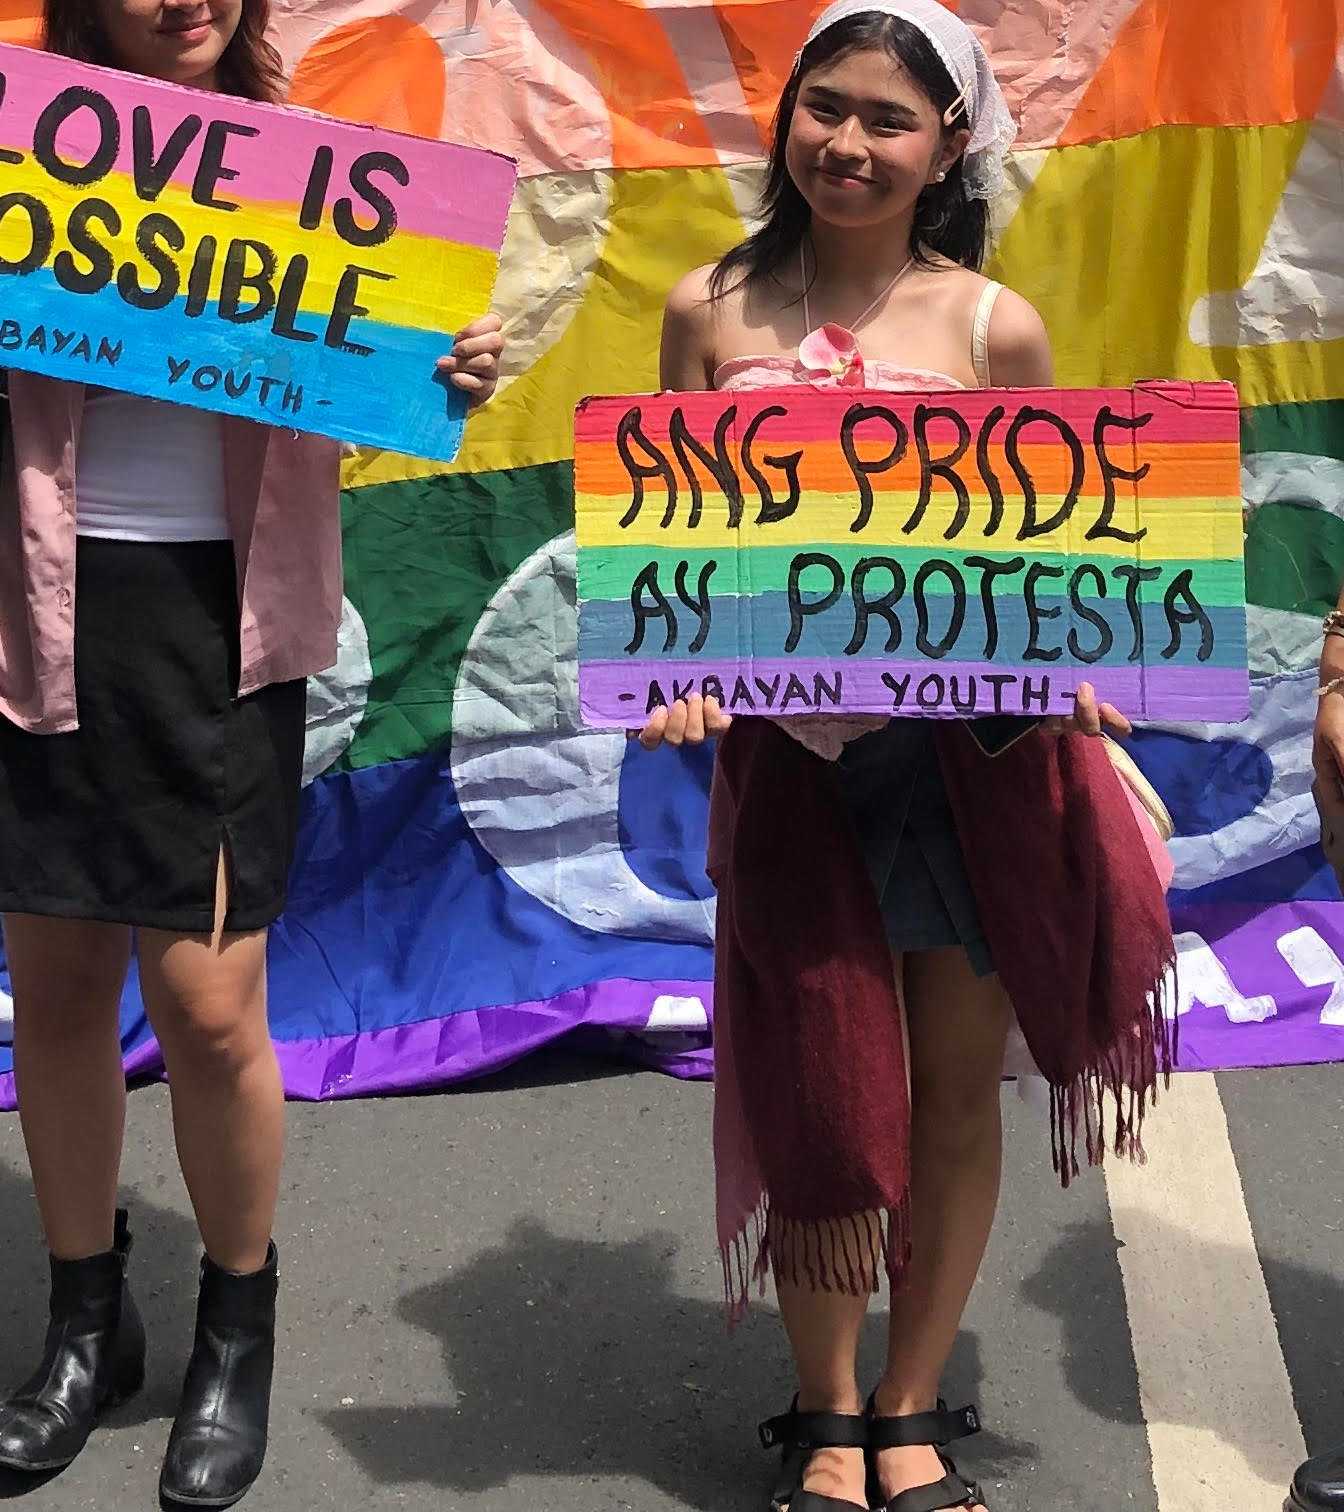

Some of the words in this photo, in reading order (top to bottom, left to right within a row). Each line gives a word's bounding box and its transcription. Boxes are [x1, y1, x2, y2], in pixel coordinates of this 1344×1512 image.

[299, 144, 411, 248] IS
[616, 404, 804, 530] ANG
[838, 402, 1154, 543] PRIDE
[624, 559, 718, 655] AY
[783, 552, 1213, 665] PROTESTA
